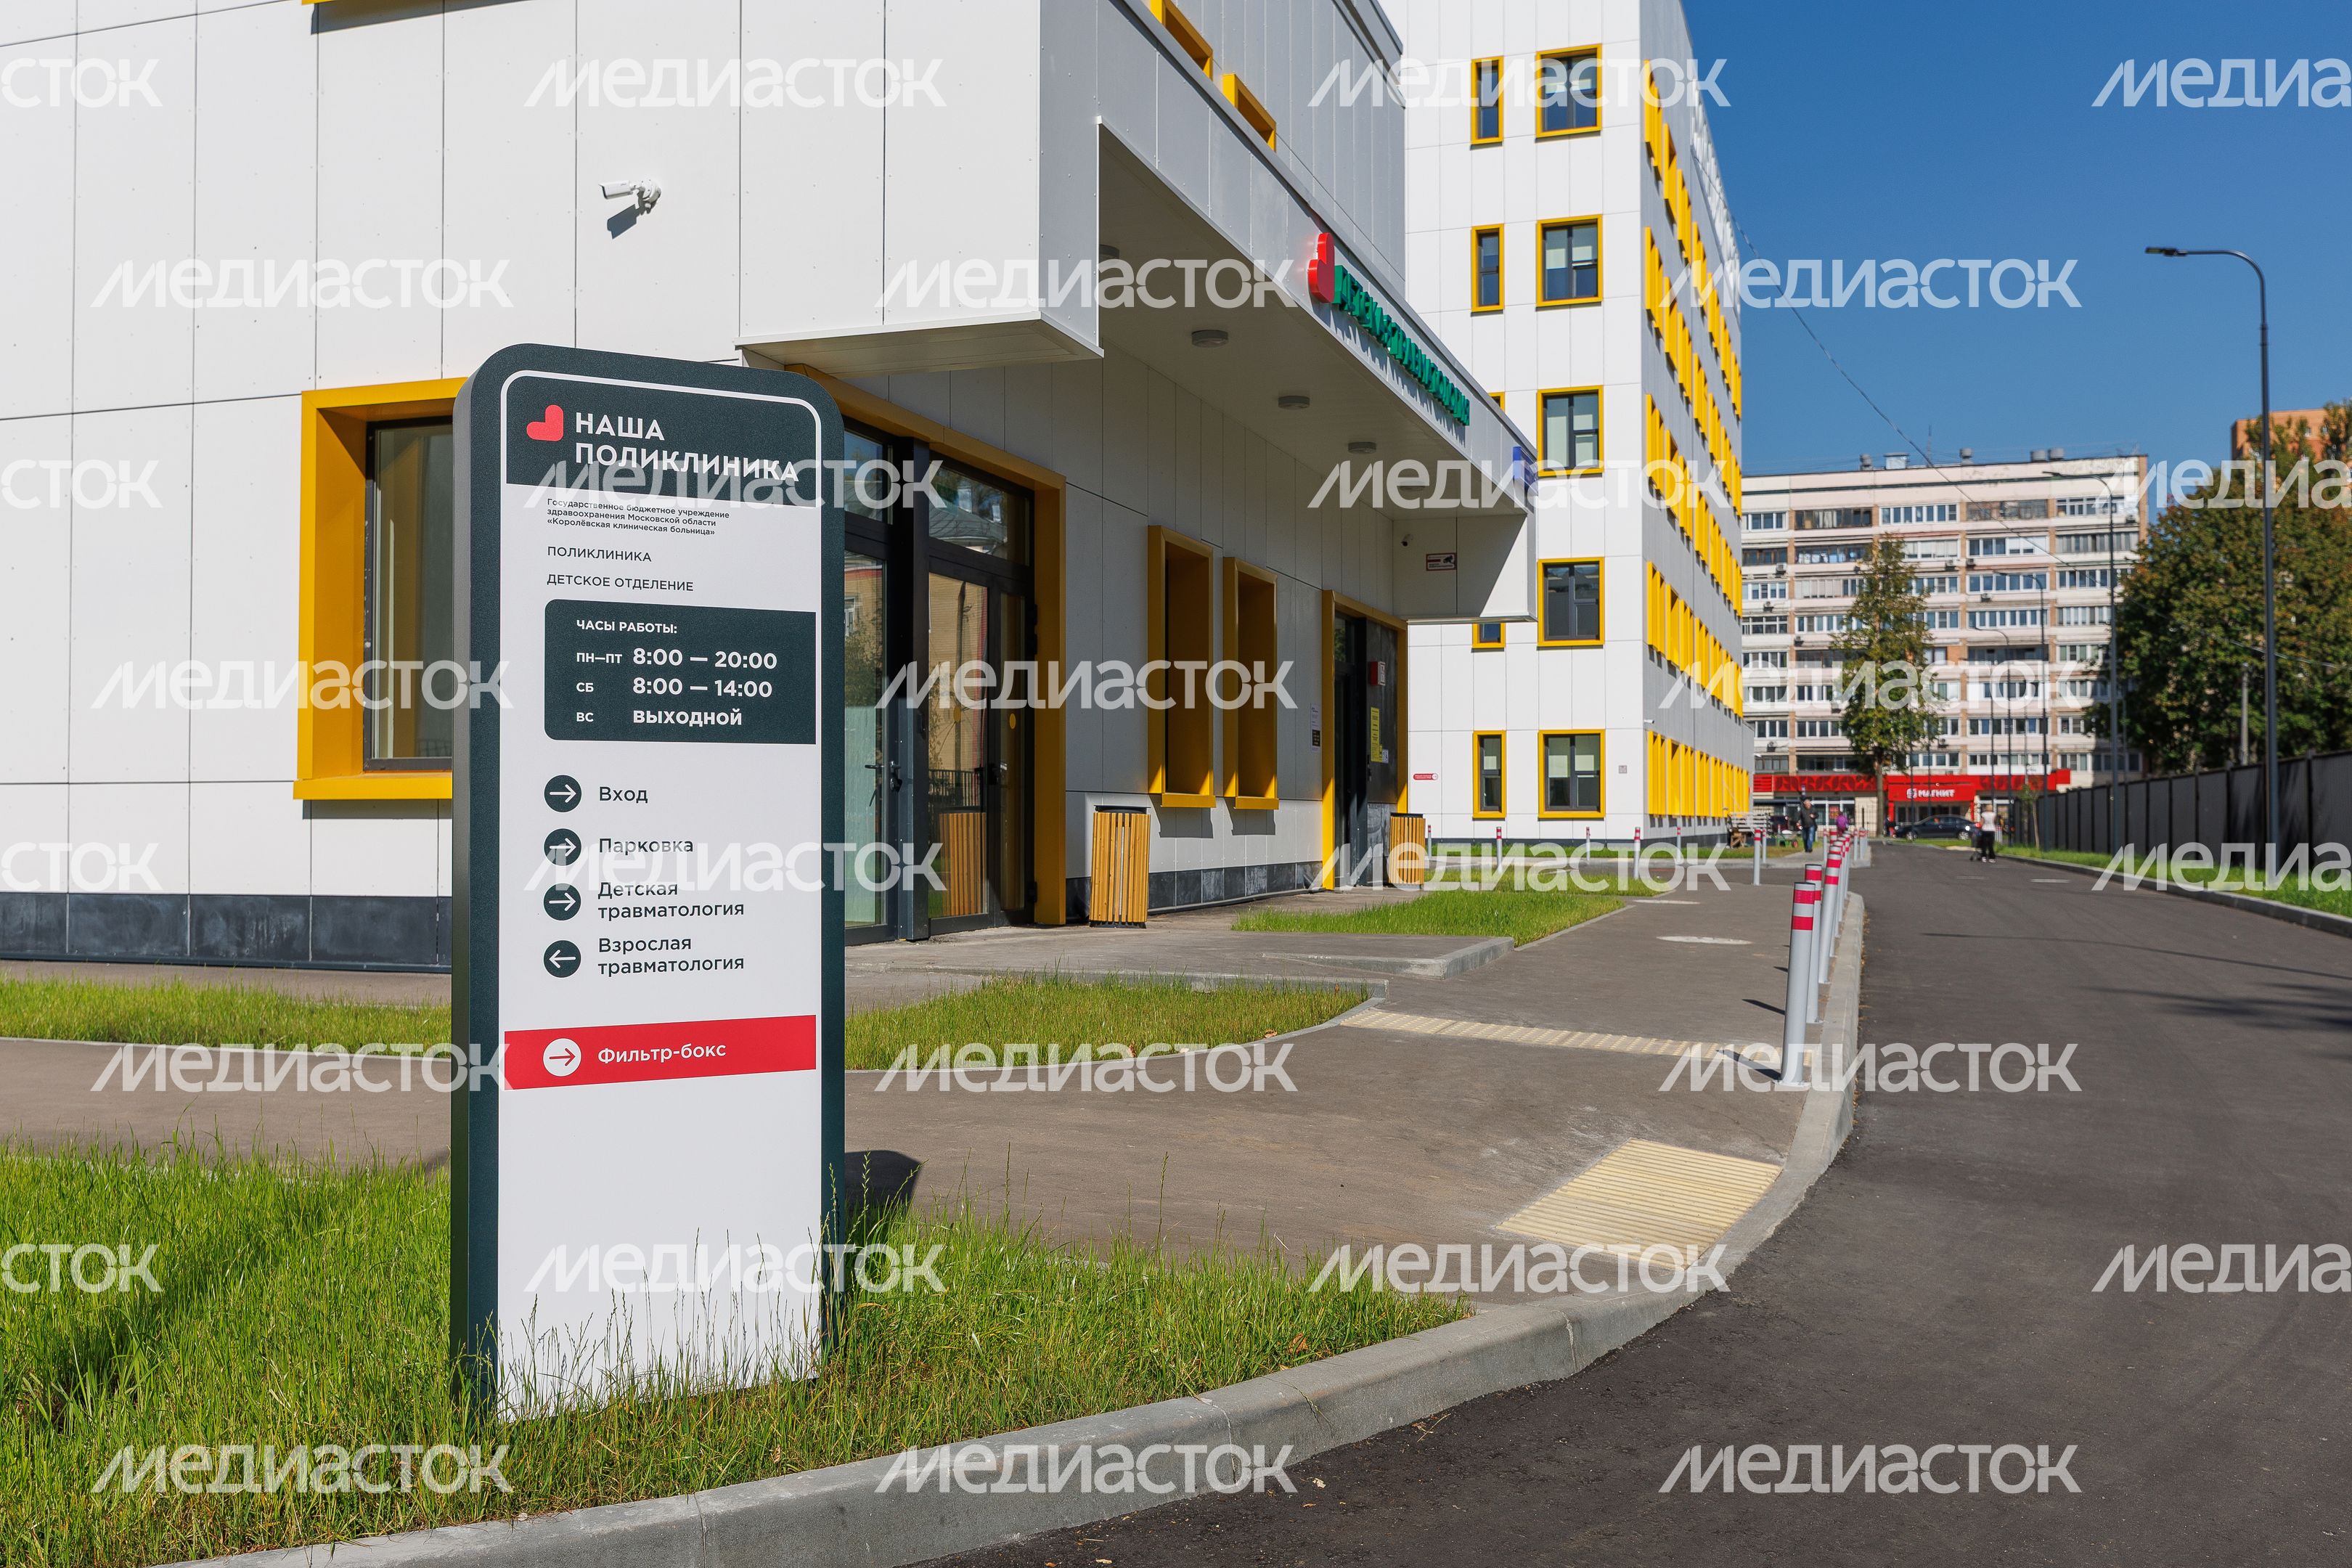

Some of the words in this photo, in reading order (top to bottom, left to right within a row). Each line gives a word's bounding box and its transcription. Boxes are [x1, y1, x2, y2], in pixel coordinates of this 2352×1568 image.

[576, 412, 665, 441] НАША
[576, 442, 799, 482] ПОЛИКЛИНИКА
[547, 498, 624, 510] Государственное
[626, 504, 676, 515] бюджетное
[677, 508, 730, 518] учреждение
[547, 510, 625, 520] здравоохранения
[628, 515, 680, 524] Московской
[547, 518, 611, 528] «Королёвская
[670, 526, 715, 535] больница»
[547, 547, 652, 562] ПОЛИКЛИНИКА
[547, 573, 611, 587] ДЕТСКОЕ
[615, 578, 694, 592] ОТДЕЛЕНИЕ
[576, 620, 615, 632] ЧАСЫ
[619, 622, 677, 634] РАБОТЫ:
[633, 648, 683, 666] 8:00
[714, 651, 777, 669] 20:00
[576, 682, 594, 693] СБ
[633, 677, 683, 695] 8:00
[714, 679, 772, 698] 14:00
[576, 712, 594, 722] ВС
[633, 709, 742, 727] ВЫХОДНОЙ
[599, 786, 648, 804] Вход
[1918, 788, 1955, 798] МАГНИТ
[599, 838, 694, 855] Парковка
[597, 882, 678, 899] Детская
[597, 904, 744, 921] травматология
[599, 938, 691, 955] Взрослая
[597, 958, 744, 977] травматология
[597, 1042, 727, 1066] Фильтр-бокс
